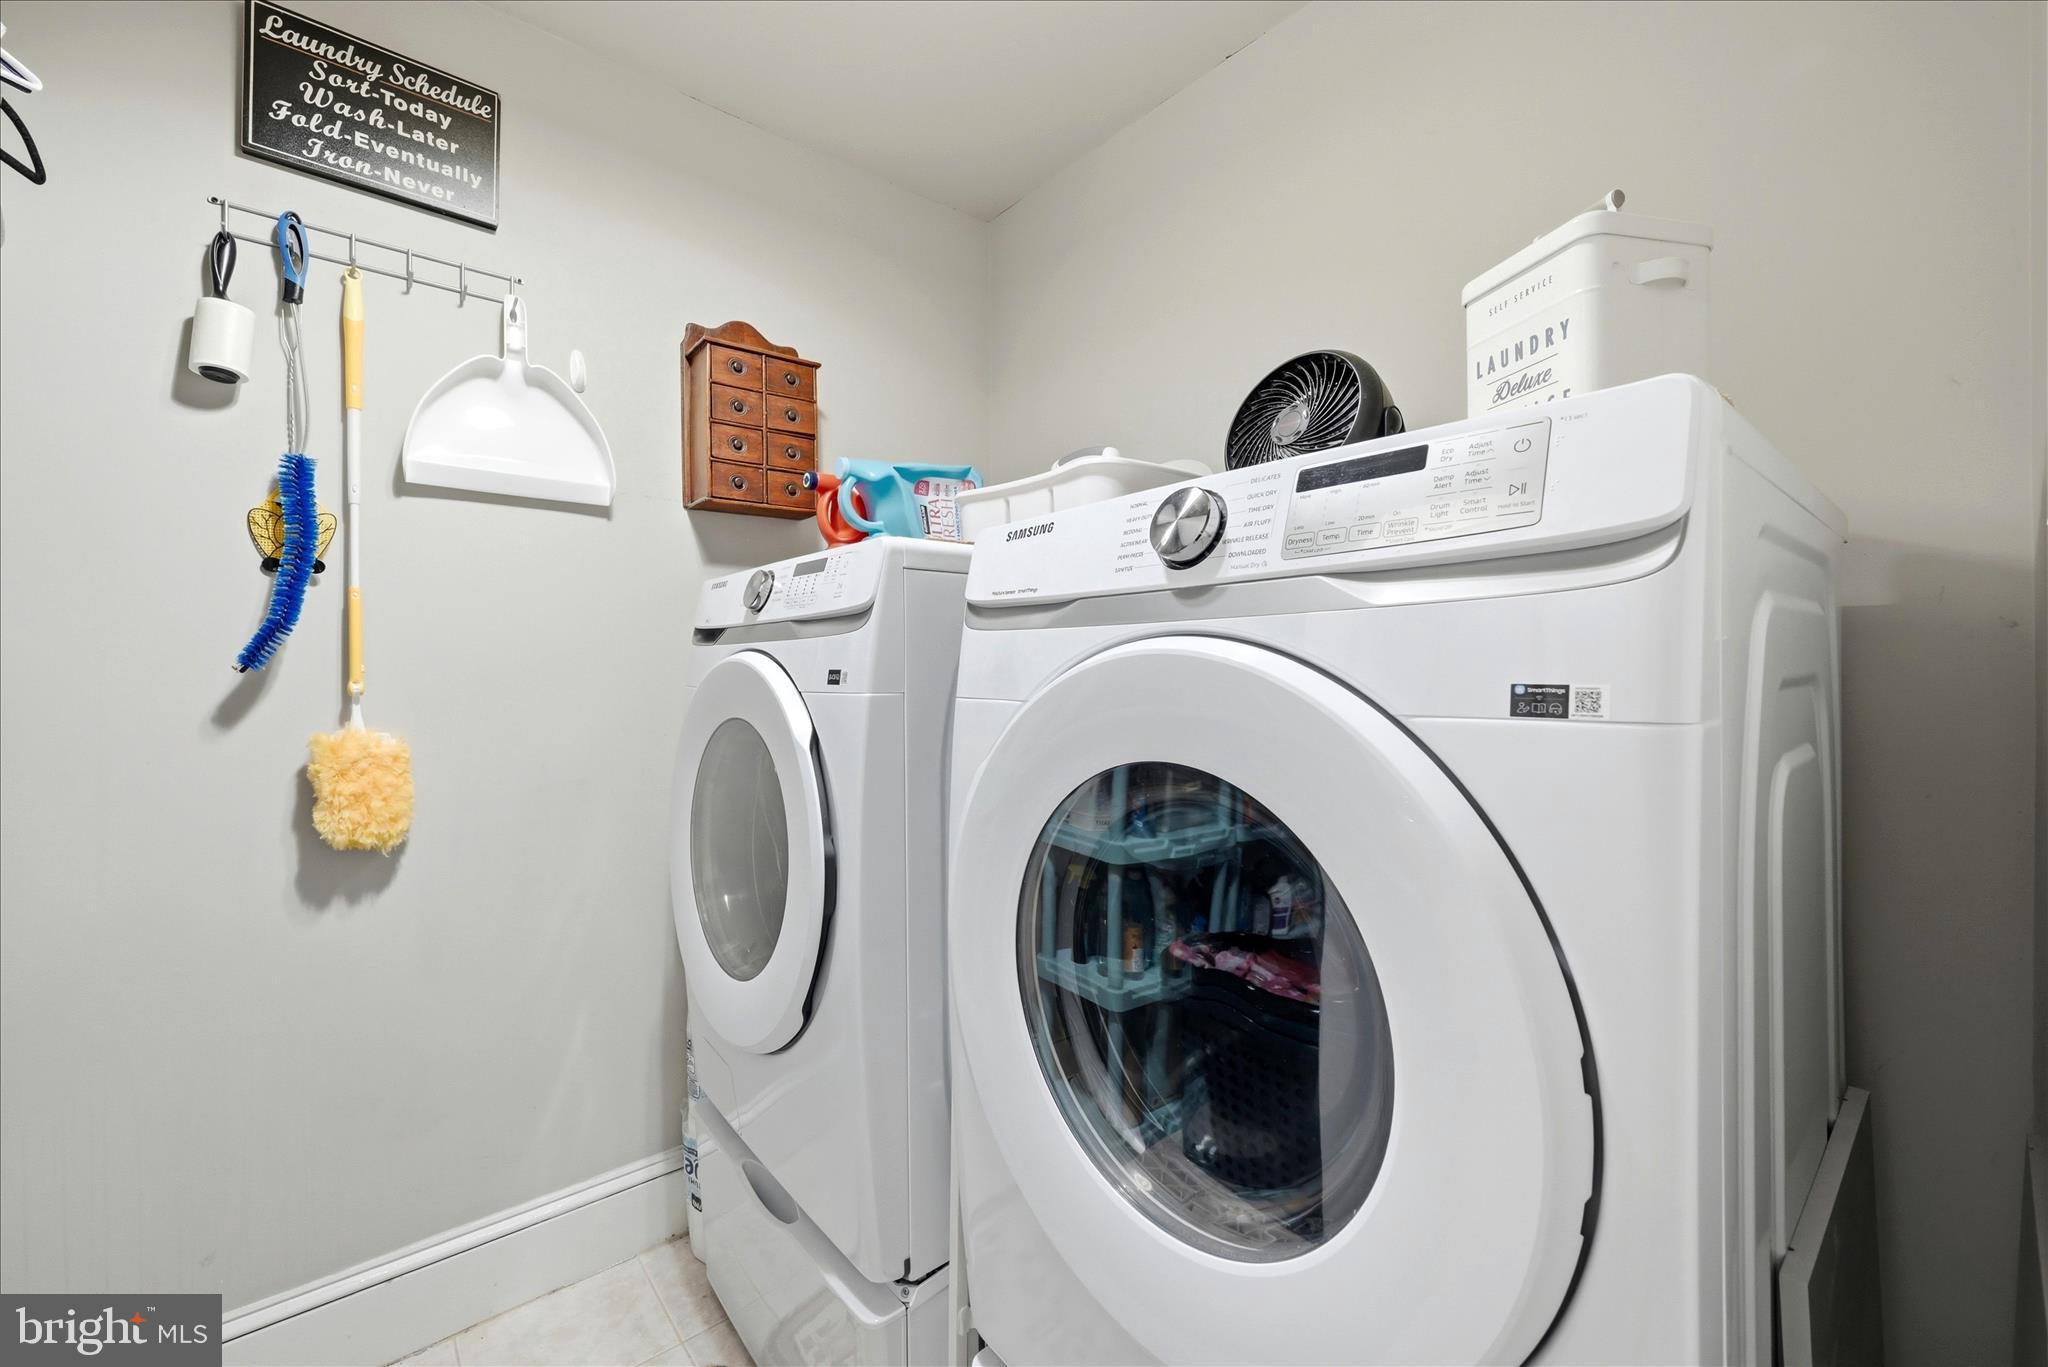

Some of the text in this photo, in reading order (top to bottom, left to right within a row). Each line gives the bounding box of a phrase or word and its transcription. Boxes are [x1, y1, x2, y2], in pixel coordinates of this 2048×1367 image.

[259, 15, 492, 119] Laundry Schedule
[309, 61, 452, 130] Sort-Today
[299, 82, 459, 154] Wash-Later
[268, 100, 482, 189] Fold-Eventually
[302, 138, 455, 201] Iron-Never
[1488, 274, 1554, 317] SELF SERVICE
[1476, 318, 1570, 380] LAUNDRY
[1492, 367, 1553, 404] Deluxe
[1468, 440, 1493, 450] Adjust
[1468, 449, 1486, 457] Time
[1433, 473, 1455, 483] Damp
[1464, 468, 1489, 478] Adjust
[1250, 473, 1281, 484] DELICATES
[1464, 477, 1482, 485] Time
[1433, 482, 1453, 490] Alert
[1463, 497, 1486, 506] Smart
[1430, 503, 1450, 511] Drum
[1459, 505, 1488, 514] Control
[940, 499, 956, 538] RESH
[1430, 510, 1449, 519] Light
[1006, 522, 1055, 542] SAMSUNG
[1357, 528, 1374, 536] Time
[1288, 536, 1313, 546] Dryness
